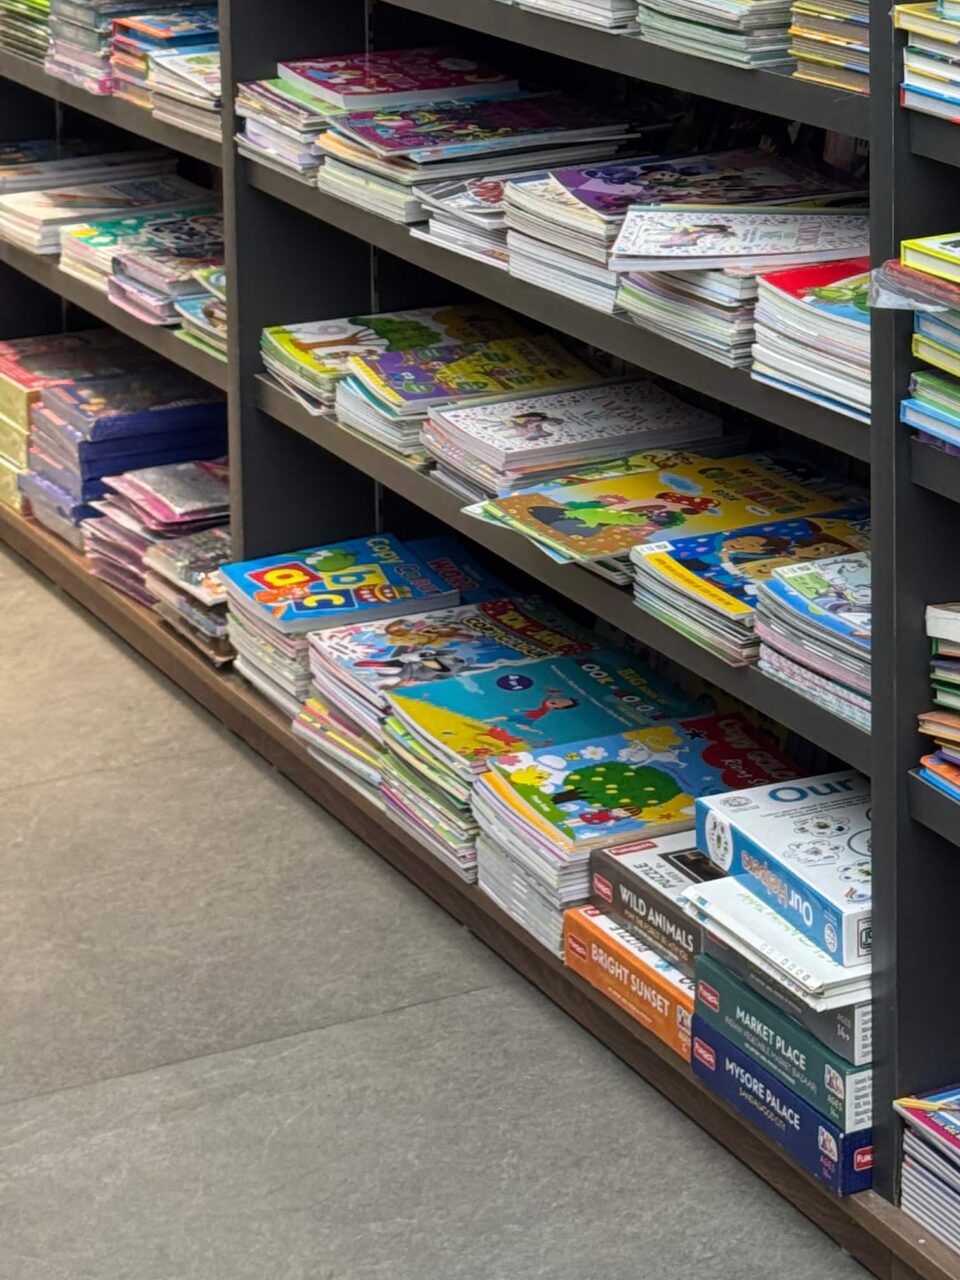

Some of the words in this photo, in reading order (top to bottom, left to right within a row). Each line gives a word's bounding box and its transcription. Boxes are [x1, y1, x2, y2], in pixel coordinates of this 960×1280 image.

[768, 778, 853, 803] Our
[620, 883, 647, 917] WILD
[648, 906, 695, 953] ANIMALS
[591, 943, 629, 985] BRIGHT
[630, 973, 671, 1017] SUNSET
[735, 1005, 775, 1041] MARKET
[775, 1037, 807, 1072] PLACE
[725, 1056, 766, 1102] MYSORE
[766, 1094, 801, 1131] PALACE
